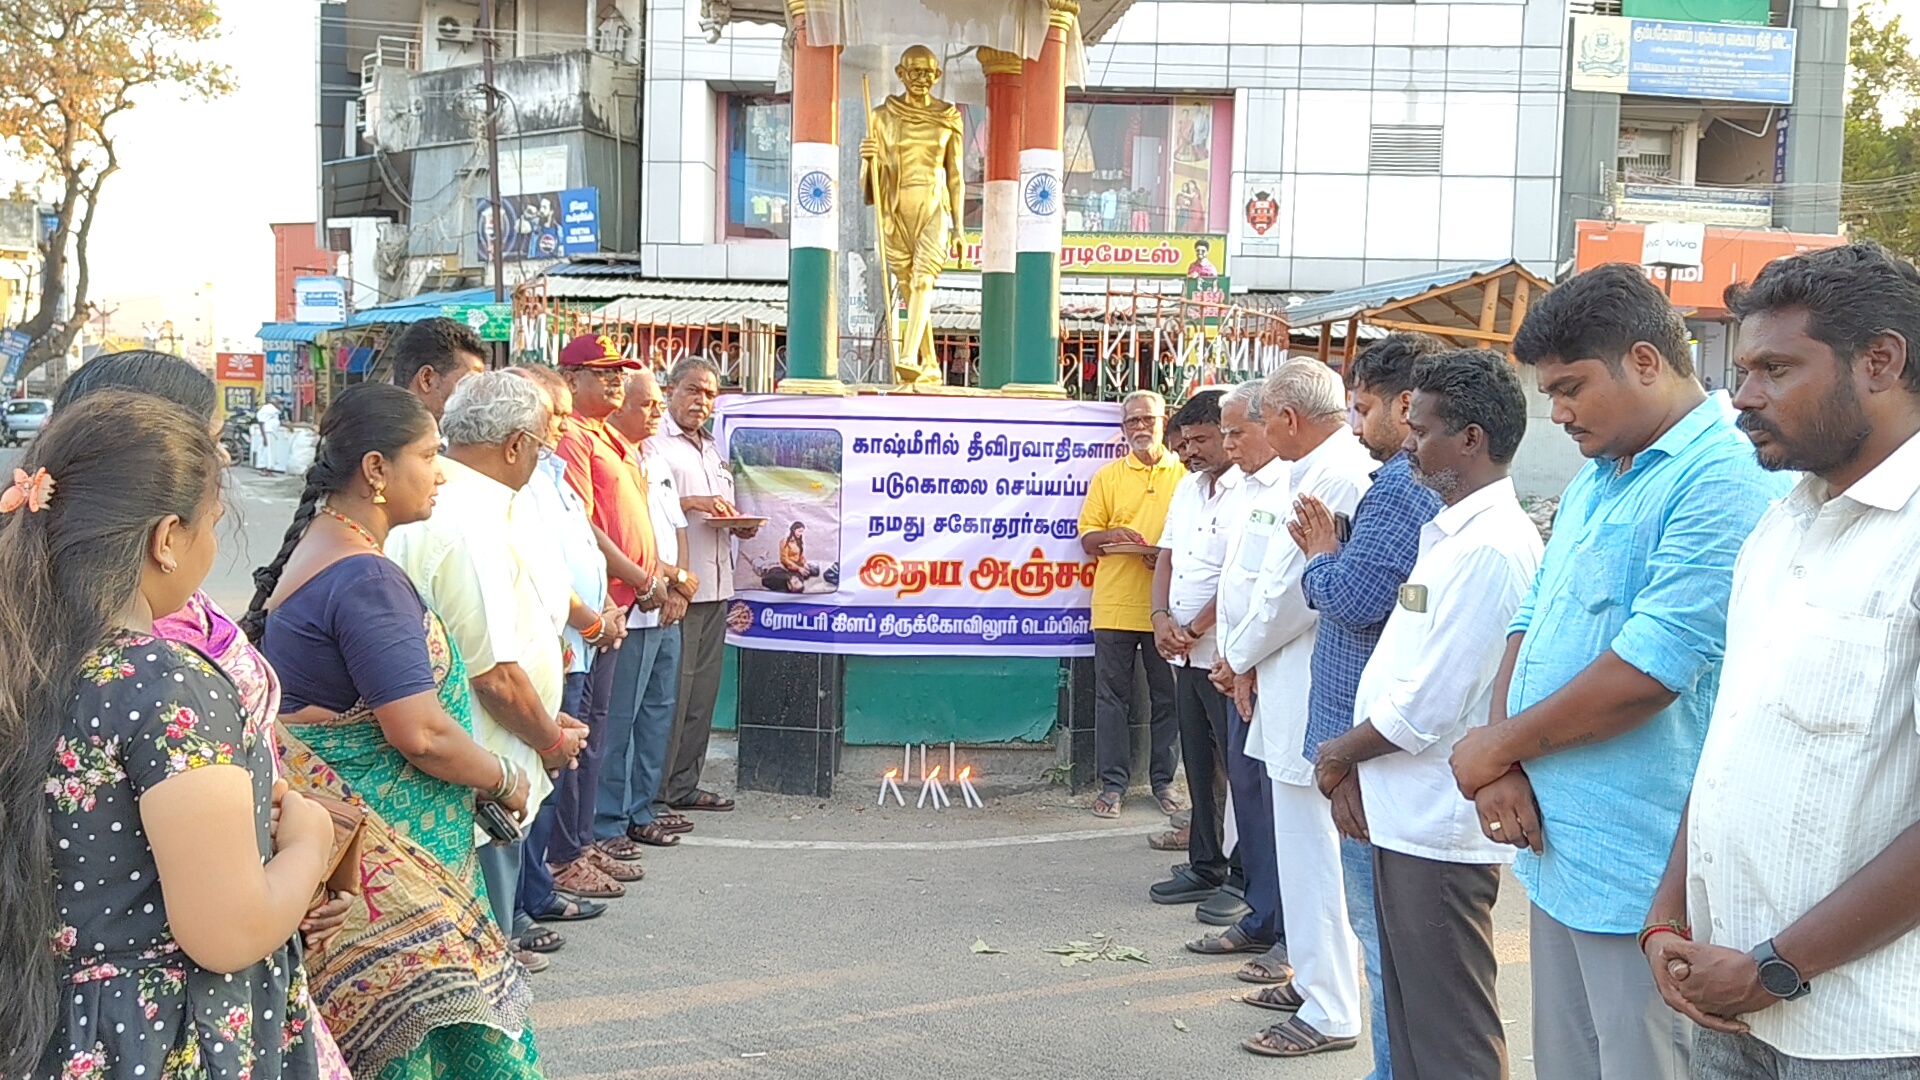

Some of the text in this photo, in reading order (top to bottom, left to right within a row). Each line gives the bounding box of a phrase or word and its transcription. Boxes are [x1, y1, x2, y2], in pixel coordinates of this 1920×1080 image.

[1061, 242, 1180, 267] ரடிமேட்ஸ்
[1666, 238, 1697, 250] vivo
[852, 429, 1130, 464] காஷ்மீரில் தீவிரவாதிகளால்
[872, 471, 1090, 500] படுகொலை செய்யப்ப
[868, 511, 1079, 543] நமது சகோதரர்களு
[859, 553, 964, 599] இதய
[760, 607, 1090, 641] ரோட்டரி கிளப் திருக்கோவிலூர் டெம்பிள்
